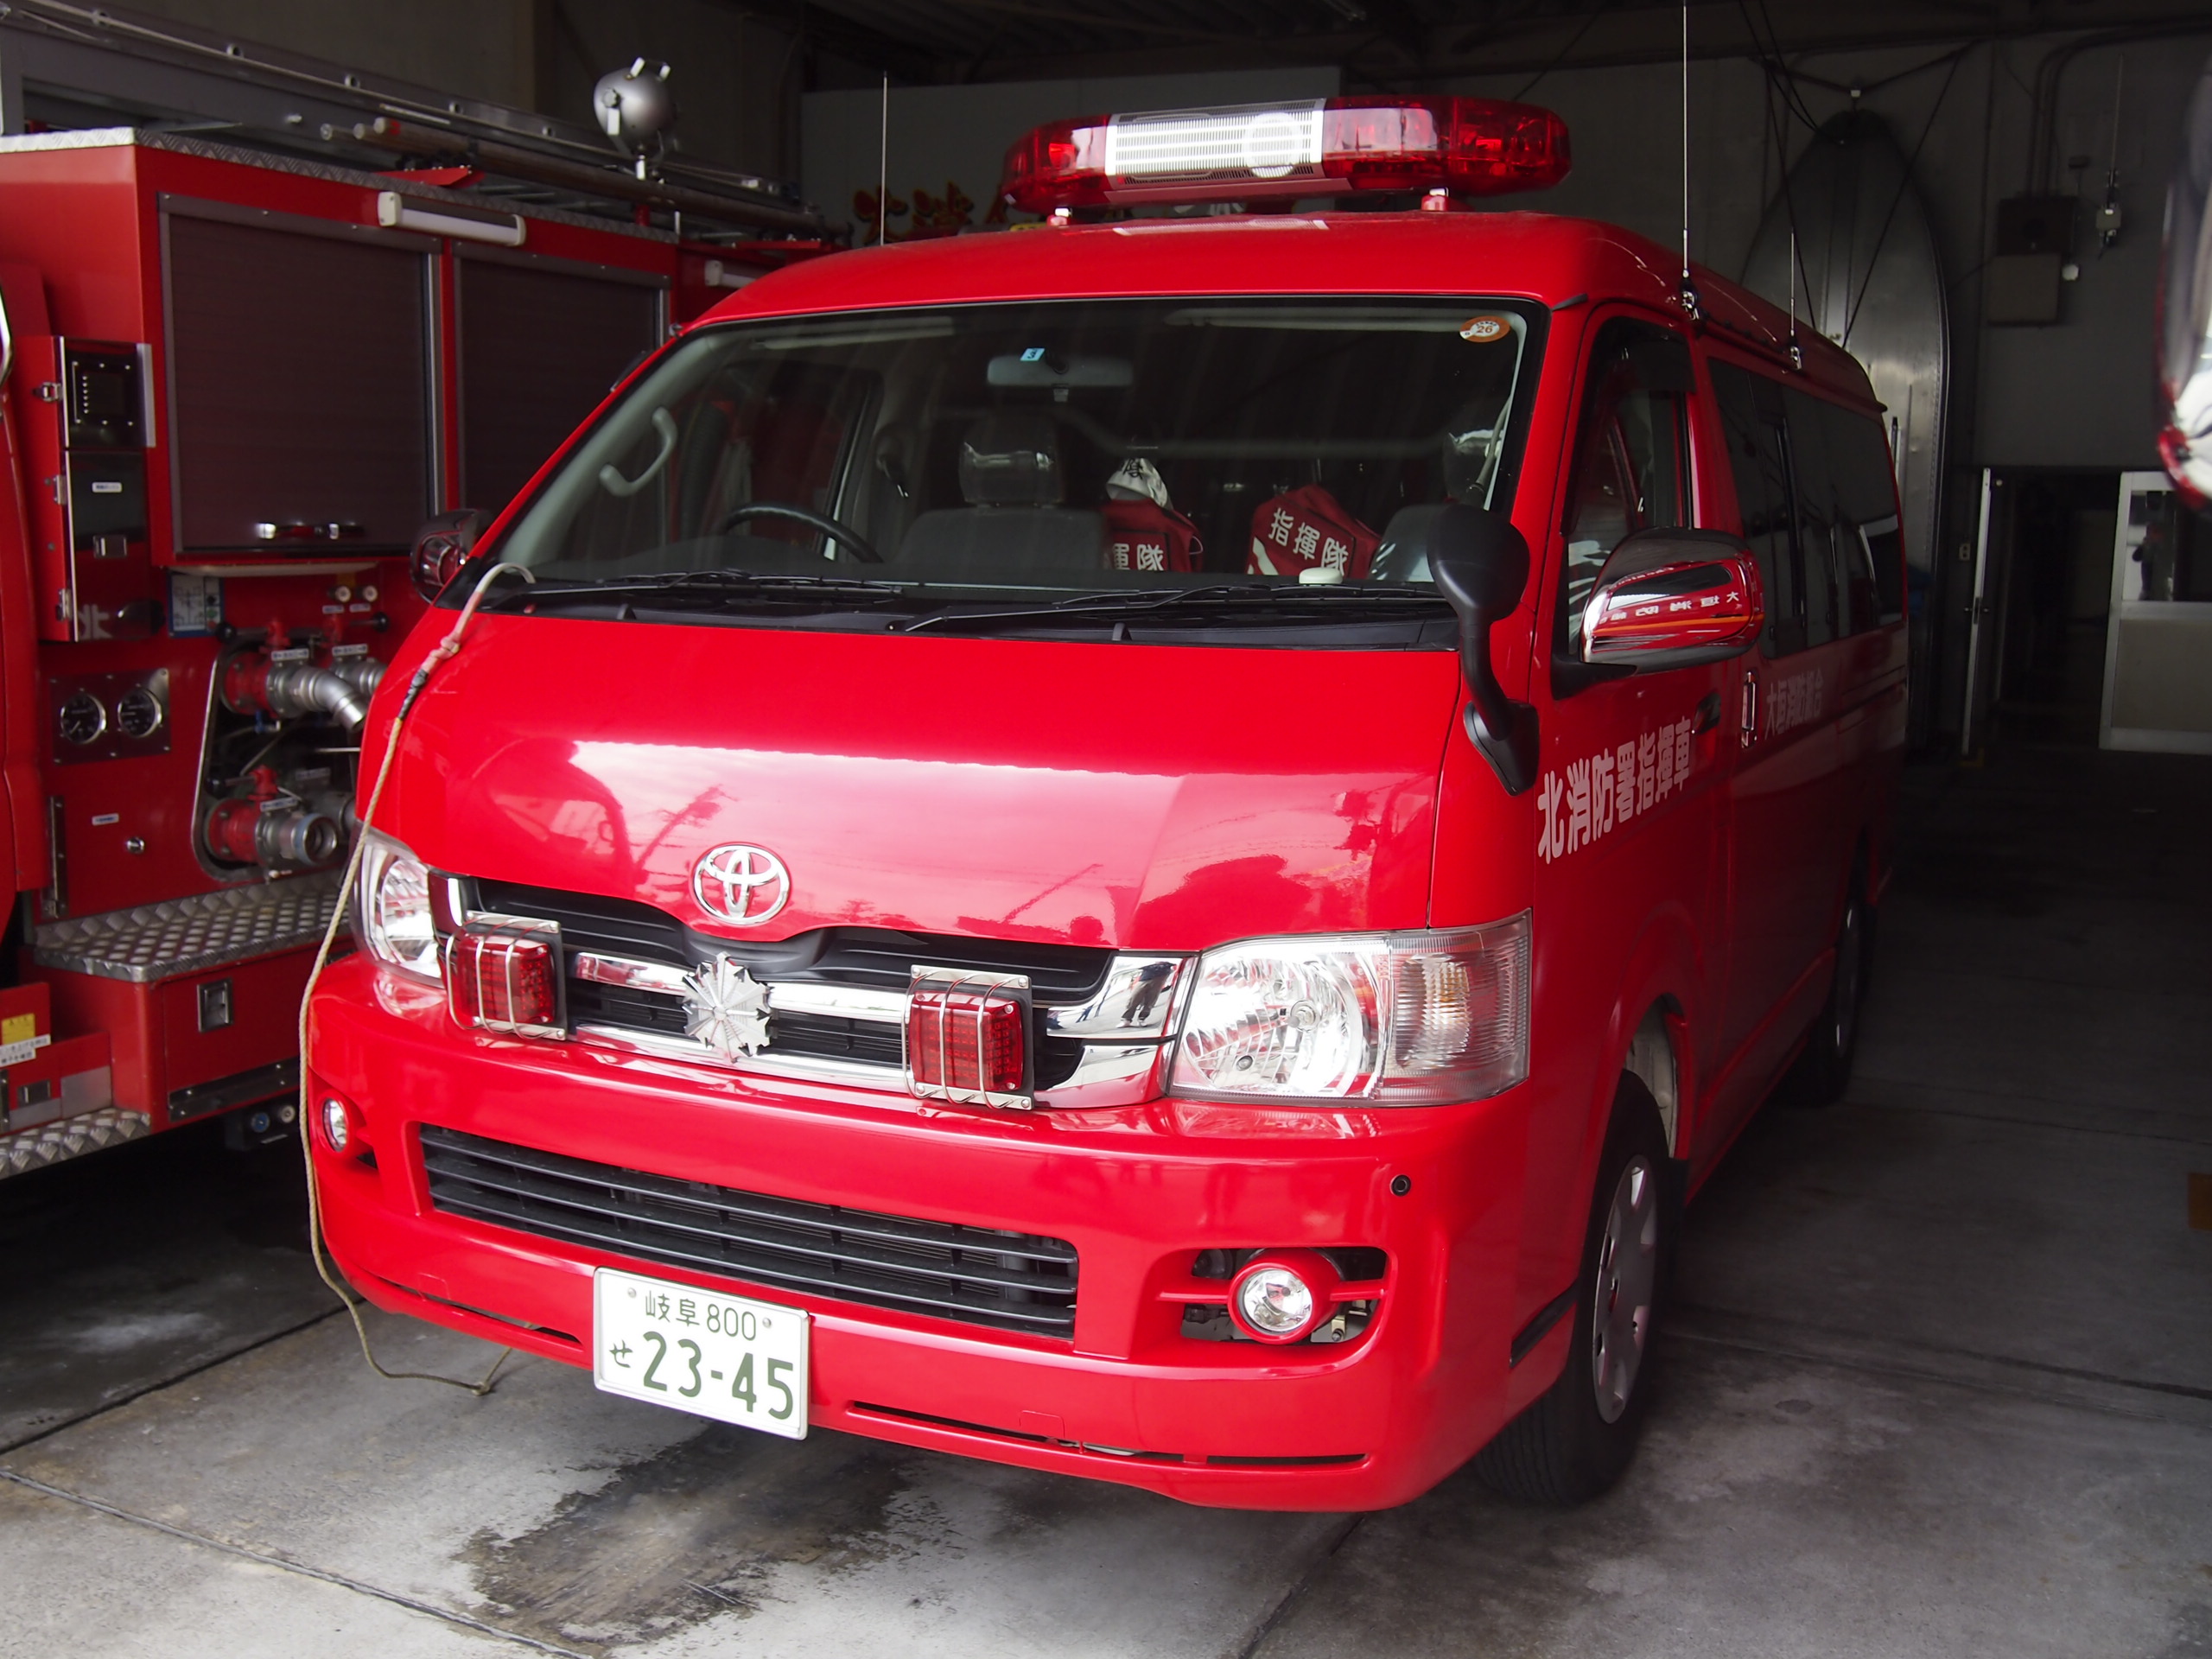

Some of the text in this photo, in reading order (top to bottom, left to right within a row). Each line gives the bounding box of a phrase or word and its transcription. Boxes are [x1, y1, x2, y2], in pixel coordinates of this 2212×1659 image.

[1476, 325, 1493, 334] 26
[1268, 507, 1350, 577] 指揮隊
[1538, 716, 1691, 865] 北消防署指揮車
[609, 1331, 793, 1420] せ 23-45
